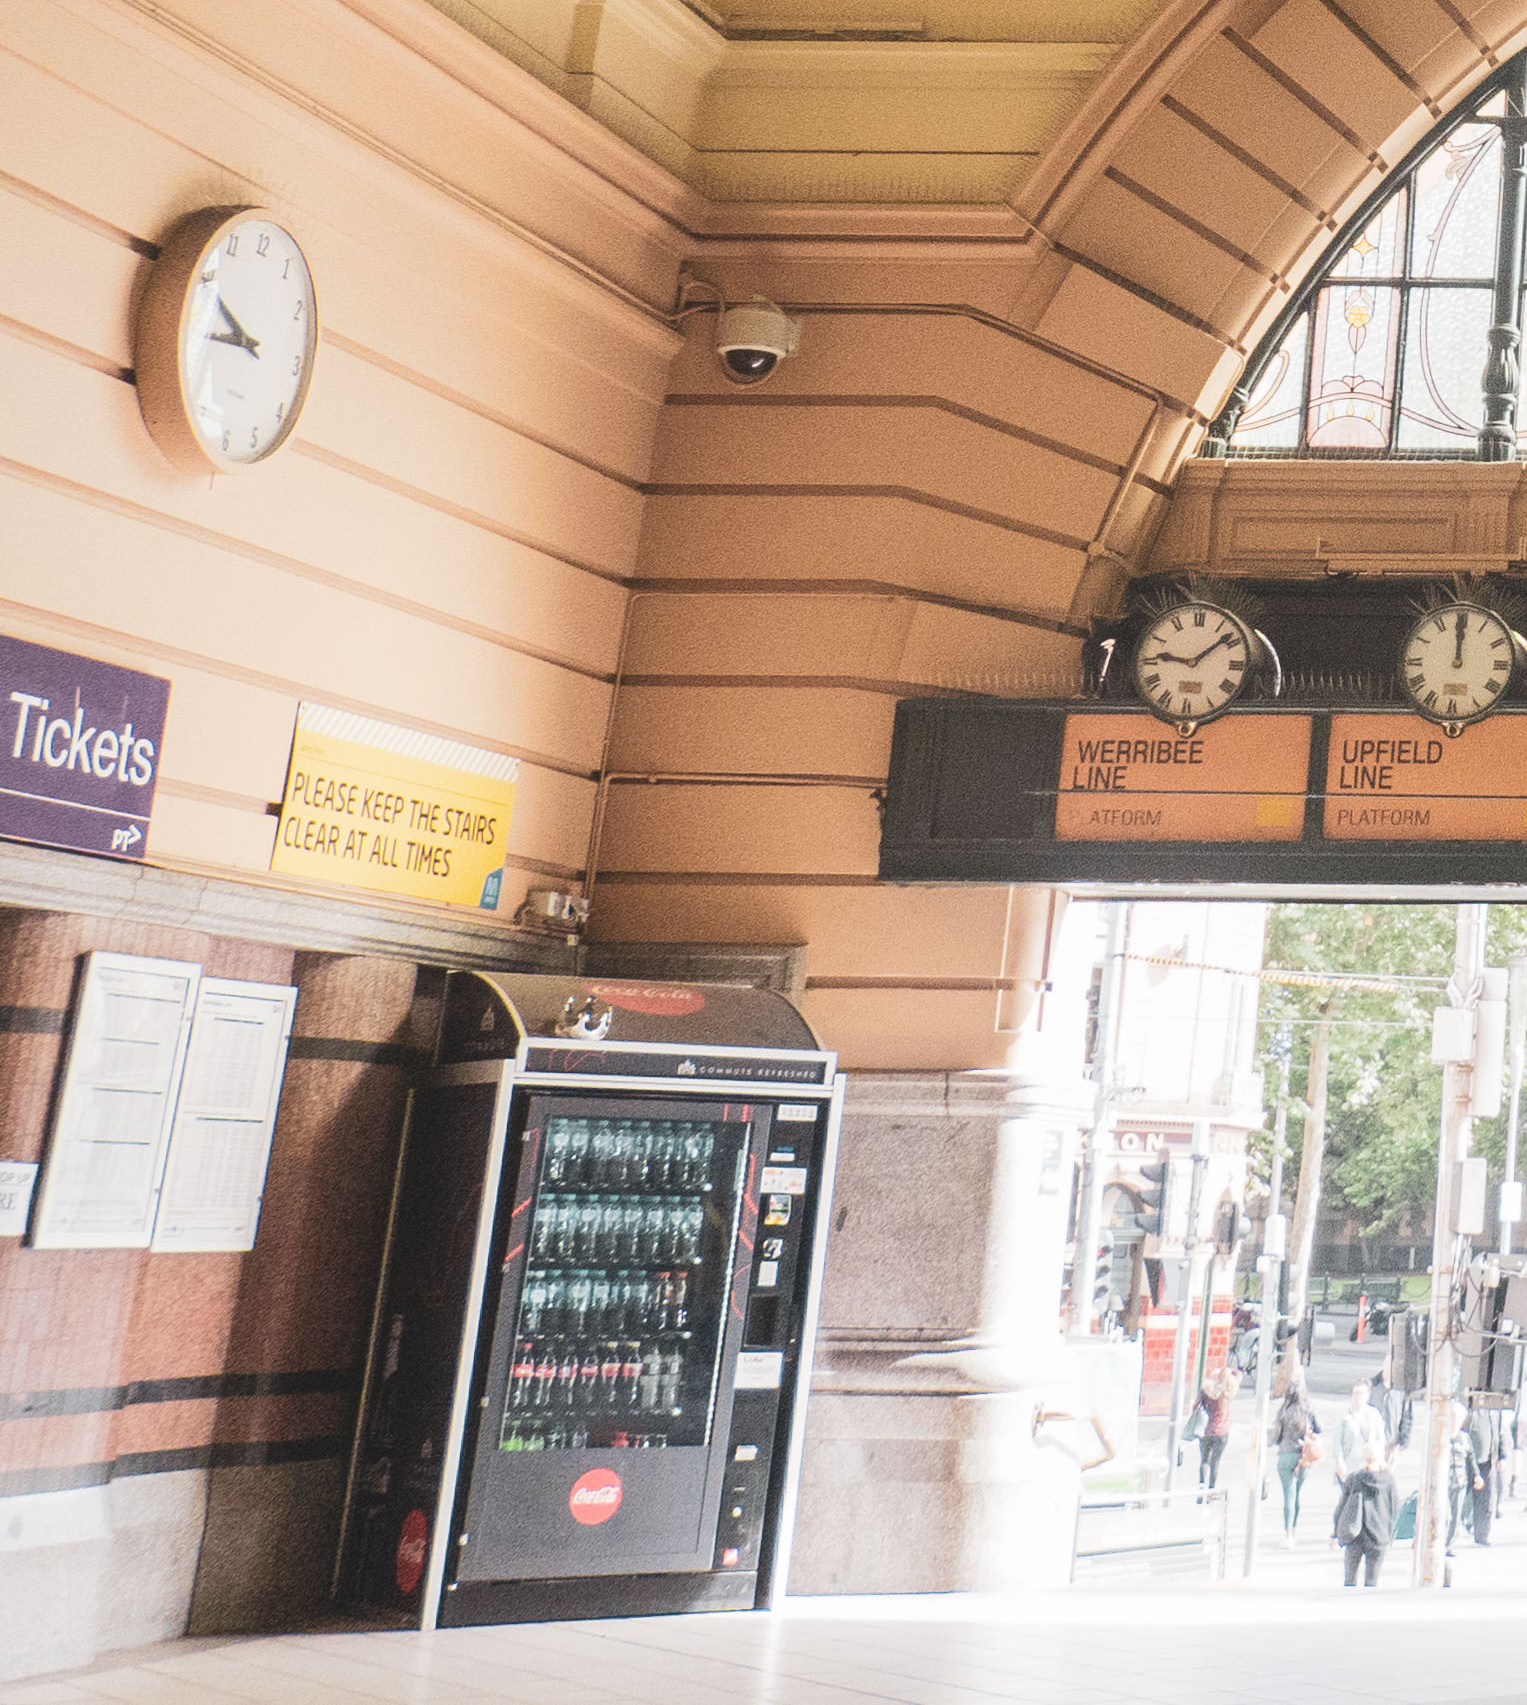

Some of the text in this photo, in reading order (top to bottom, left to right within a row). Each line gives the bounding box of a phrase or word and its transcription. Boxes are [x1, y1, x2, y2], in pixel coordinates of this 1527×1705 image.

[10, 691, 155, 786] Tickets
[1078, 740, 1204, 764] WERRIBEE
[1343, 740, 1443, 764] UPFIELD
[1072, 766, 1128, 789] LINE
[1340, 766, 1393, 789] LINE
[292, 772, 497, 845] PLEASE KEEP THE STAIRS
[1337, 809, 1430, 826] PLATFORM
[284, 816, 453, 877] CLEAR AT ALL TIMES
